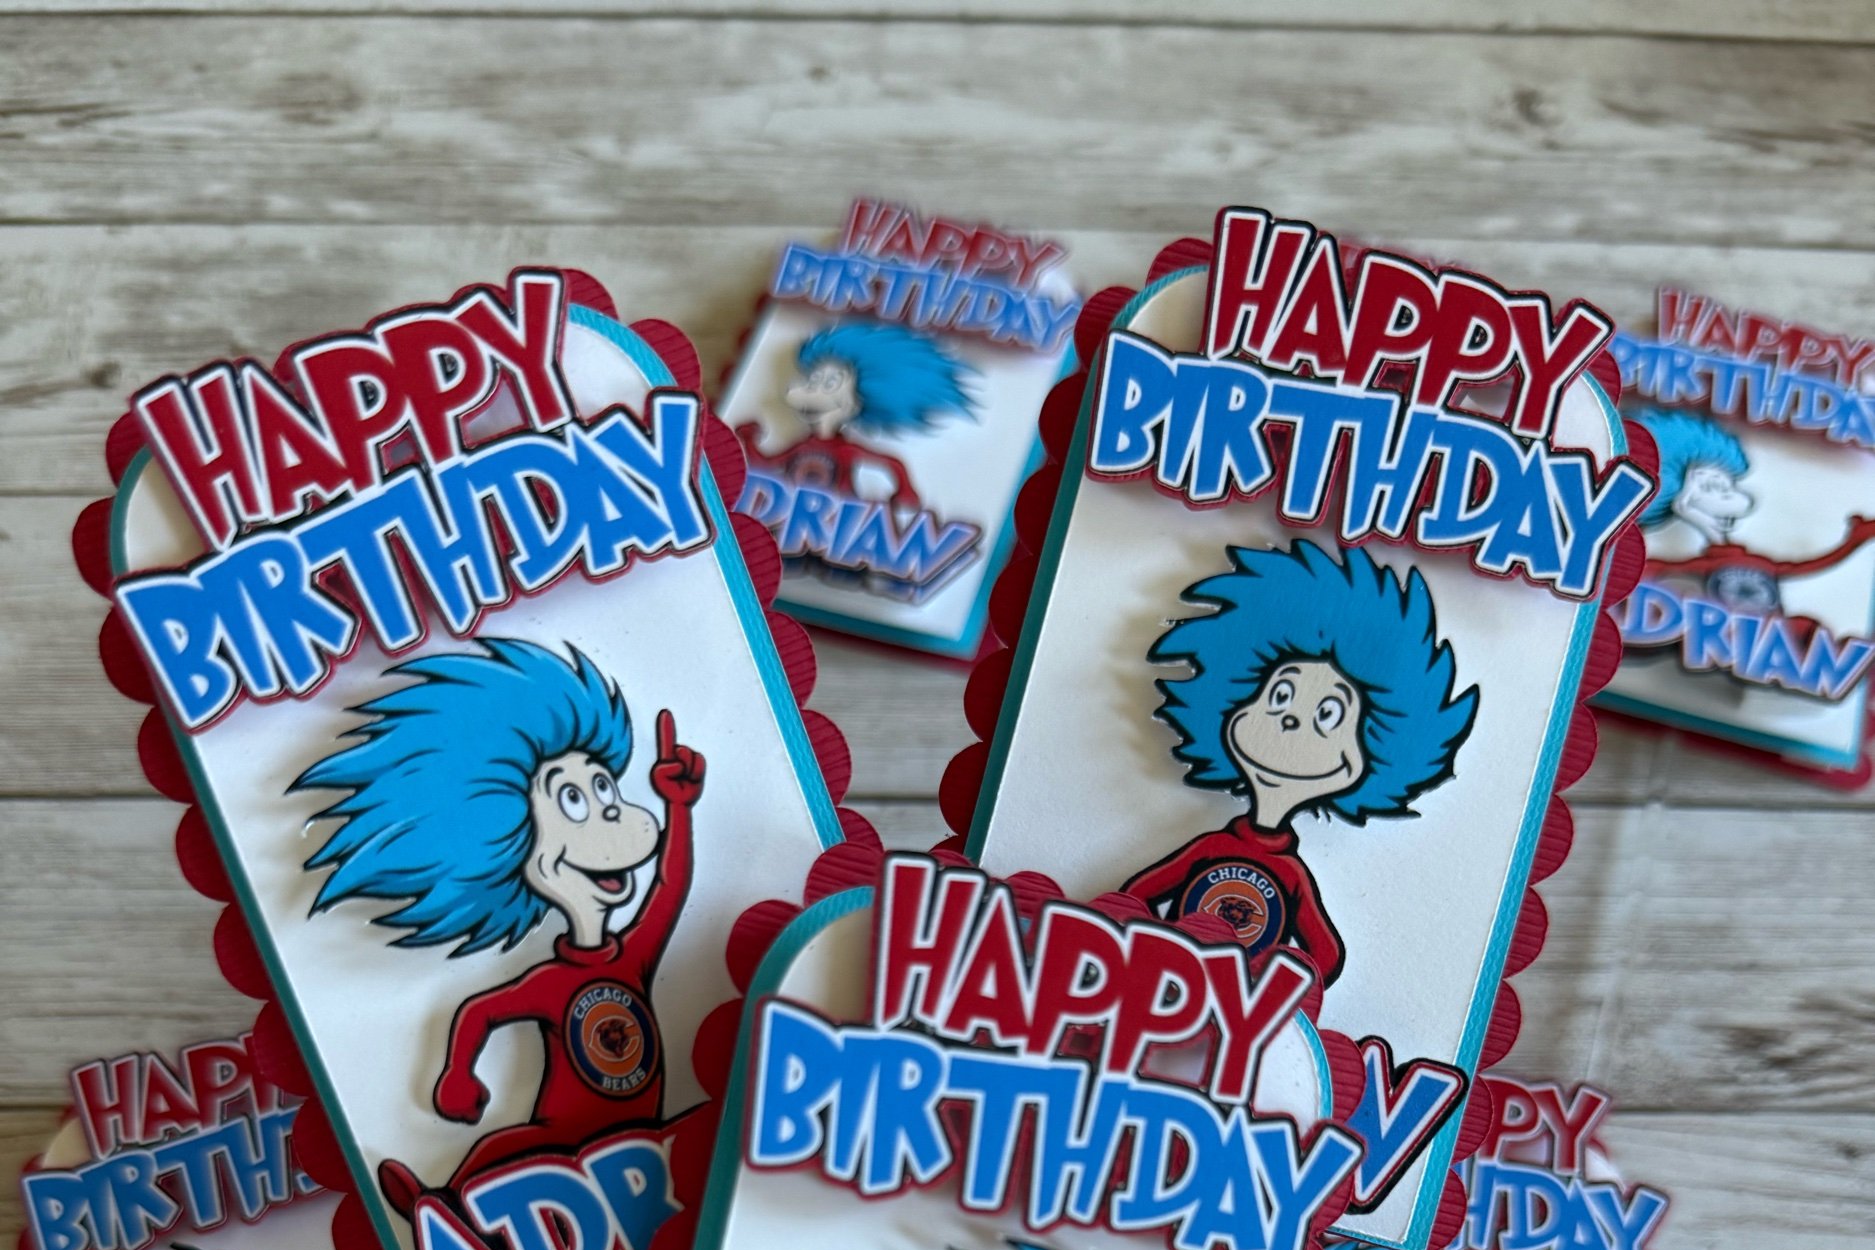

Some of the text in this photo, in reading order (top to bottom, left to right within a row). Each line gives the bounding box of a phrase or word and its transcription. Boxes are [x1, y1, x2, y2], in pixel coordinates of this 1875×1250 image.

[774, 242, 1080, 350] BIRTHDAY
[846, 198, 1067, 287] HAPPY
[1209, 210, 1607, 438] HAPPY
[1657, 284, 1875, 391] HAPPY
[136, 270, 568, 549] HAPPY
[1606, 333, 1875, 448] BIRTHDA
[1089, 331, 1655, 598] BIRTHDAY
[115, 391, 709, 726] BIRTHDAY
[737, 472, 979, 581] DRIAN
[1612, 582, 1875, 700] DRIAN
[1207, 867, 1276, 899] CHICAGO
[574, 987, 633, 1019] CHICAGO
[877, 855, 1313, 1102] HAPPY
[602, 1067, 647, 1090] BEARS
